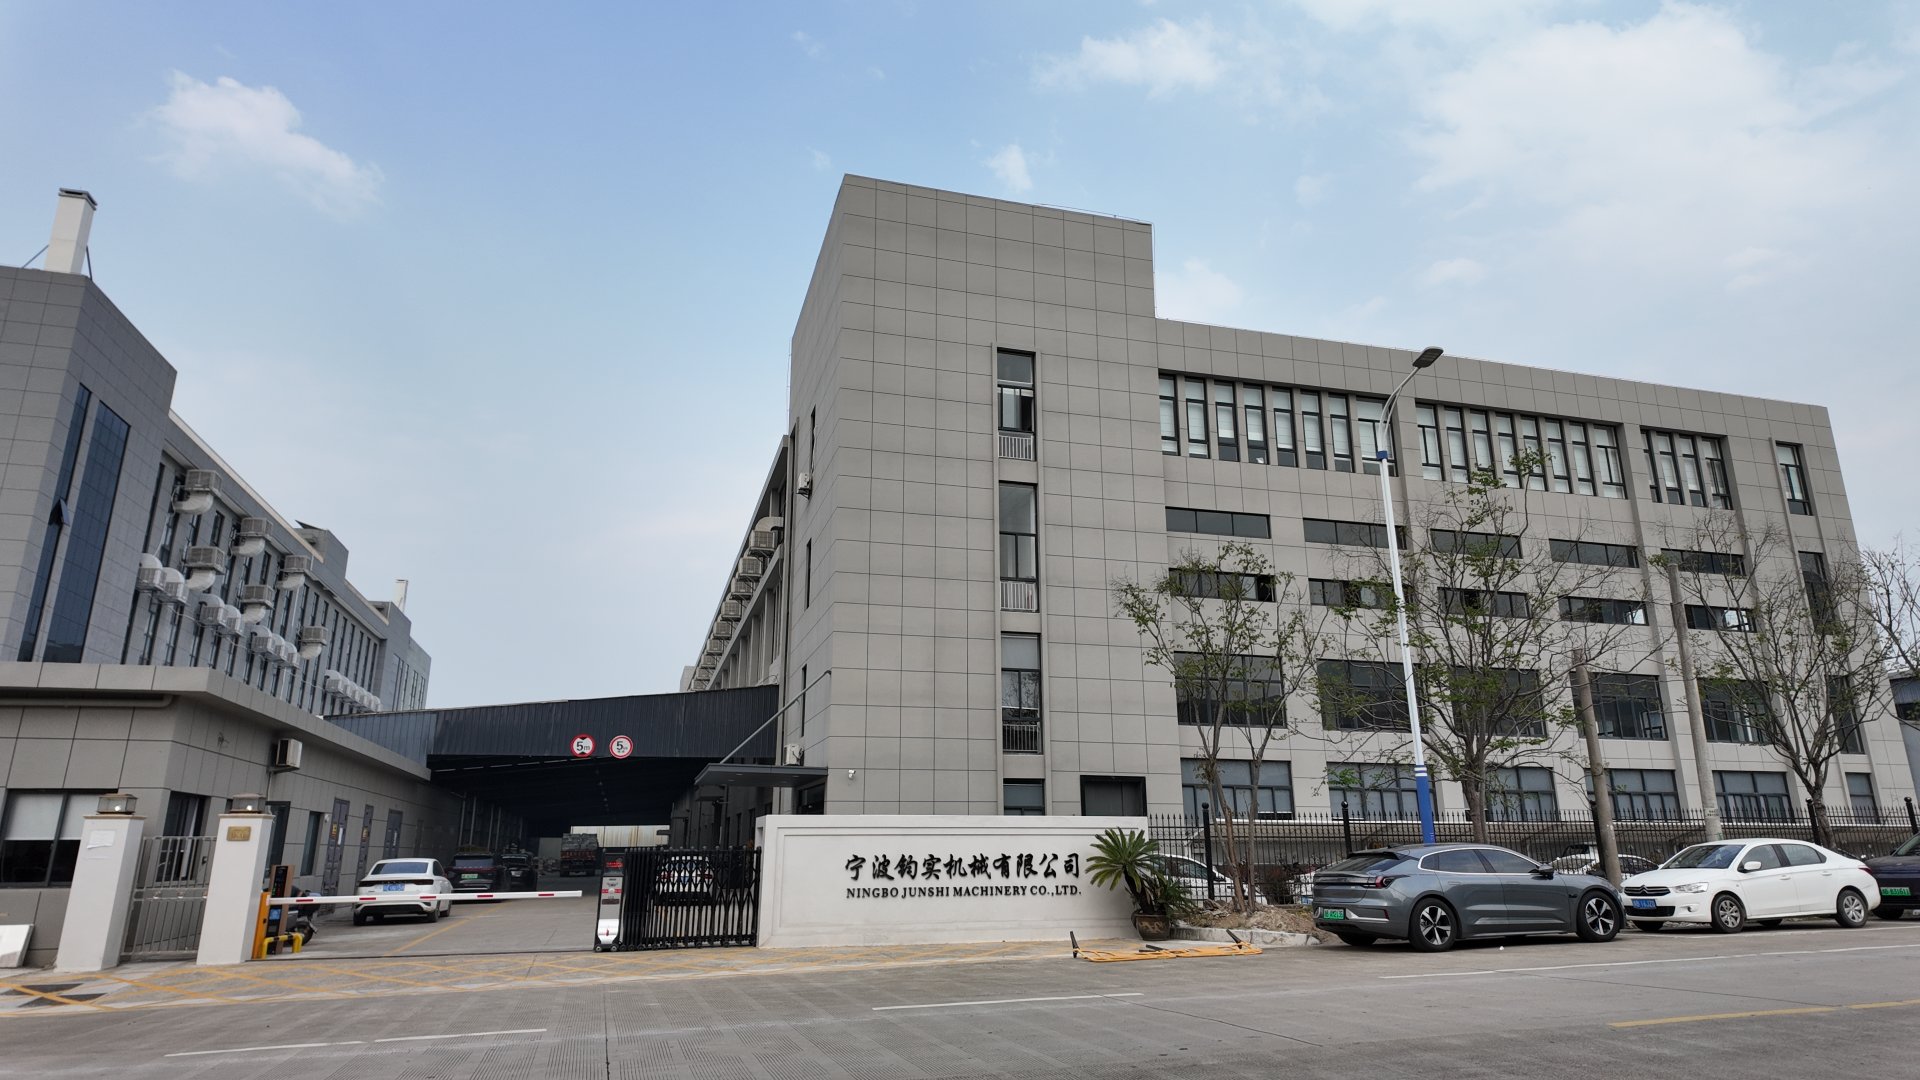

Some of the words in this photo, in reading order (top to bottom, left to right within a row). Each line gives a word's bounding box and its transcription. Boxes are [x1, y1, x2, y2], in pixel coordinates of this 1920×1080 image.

[846, 886, 899, 899] NINGBO
[901, 886, 950, 899] JUNSHI
[952, 885, 1028, 898] MACHINERY
